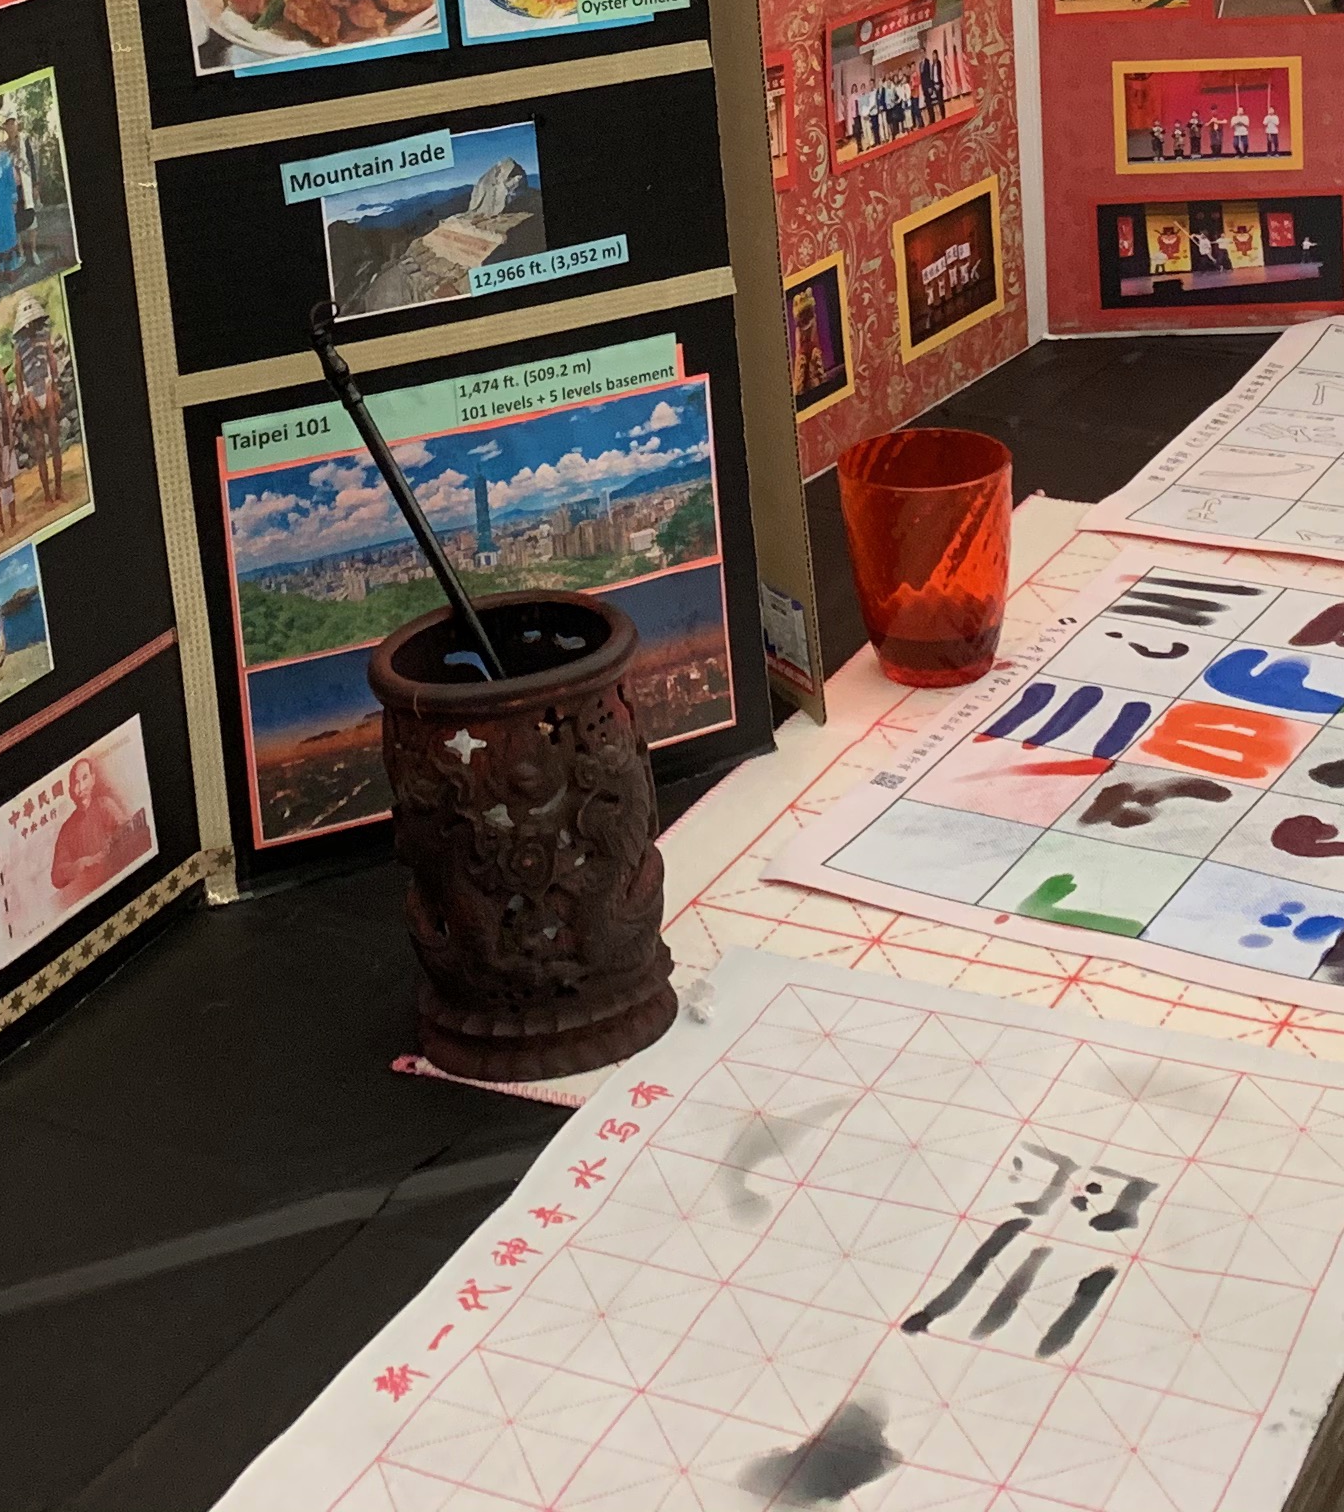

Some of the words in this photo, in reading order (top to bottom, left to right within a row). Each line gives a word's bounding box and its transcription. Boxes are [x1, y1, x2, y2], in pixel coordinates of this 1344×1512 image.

[289, 157, 394, 194] Mountain
[398, 142, 446, 172] Jade
[473, 263, 526, 290] 12,966
[529, 259, 548, 277] ft.
[551, 249, 597, 275] (3,952
[600, 241, 624, 264] m)
[459, 378, 499, 399] 1,474
[501, 373, 521, 391] ft.
[523, 363, 569, 388] (509.2
[572, 358, 592, 377] m)
[461, 405, 488, 423] 101
[490, 394, 534, 417] levels
[536, 395, 547, 406] +
[549, 389, 559, 405] 5
[561, 381, 602, 402] levels
[605, 363, 675, 393] basement
[227, 424, 290, 453] Taipei
[295, 416, 331, 437] 101
